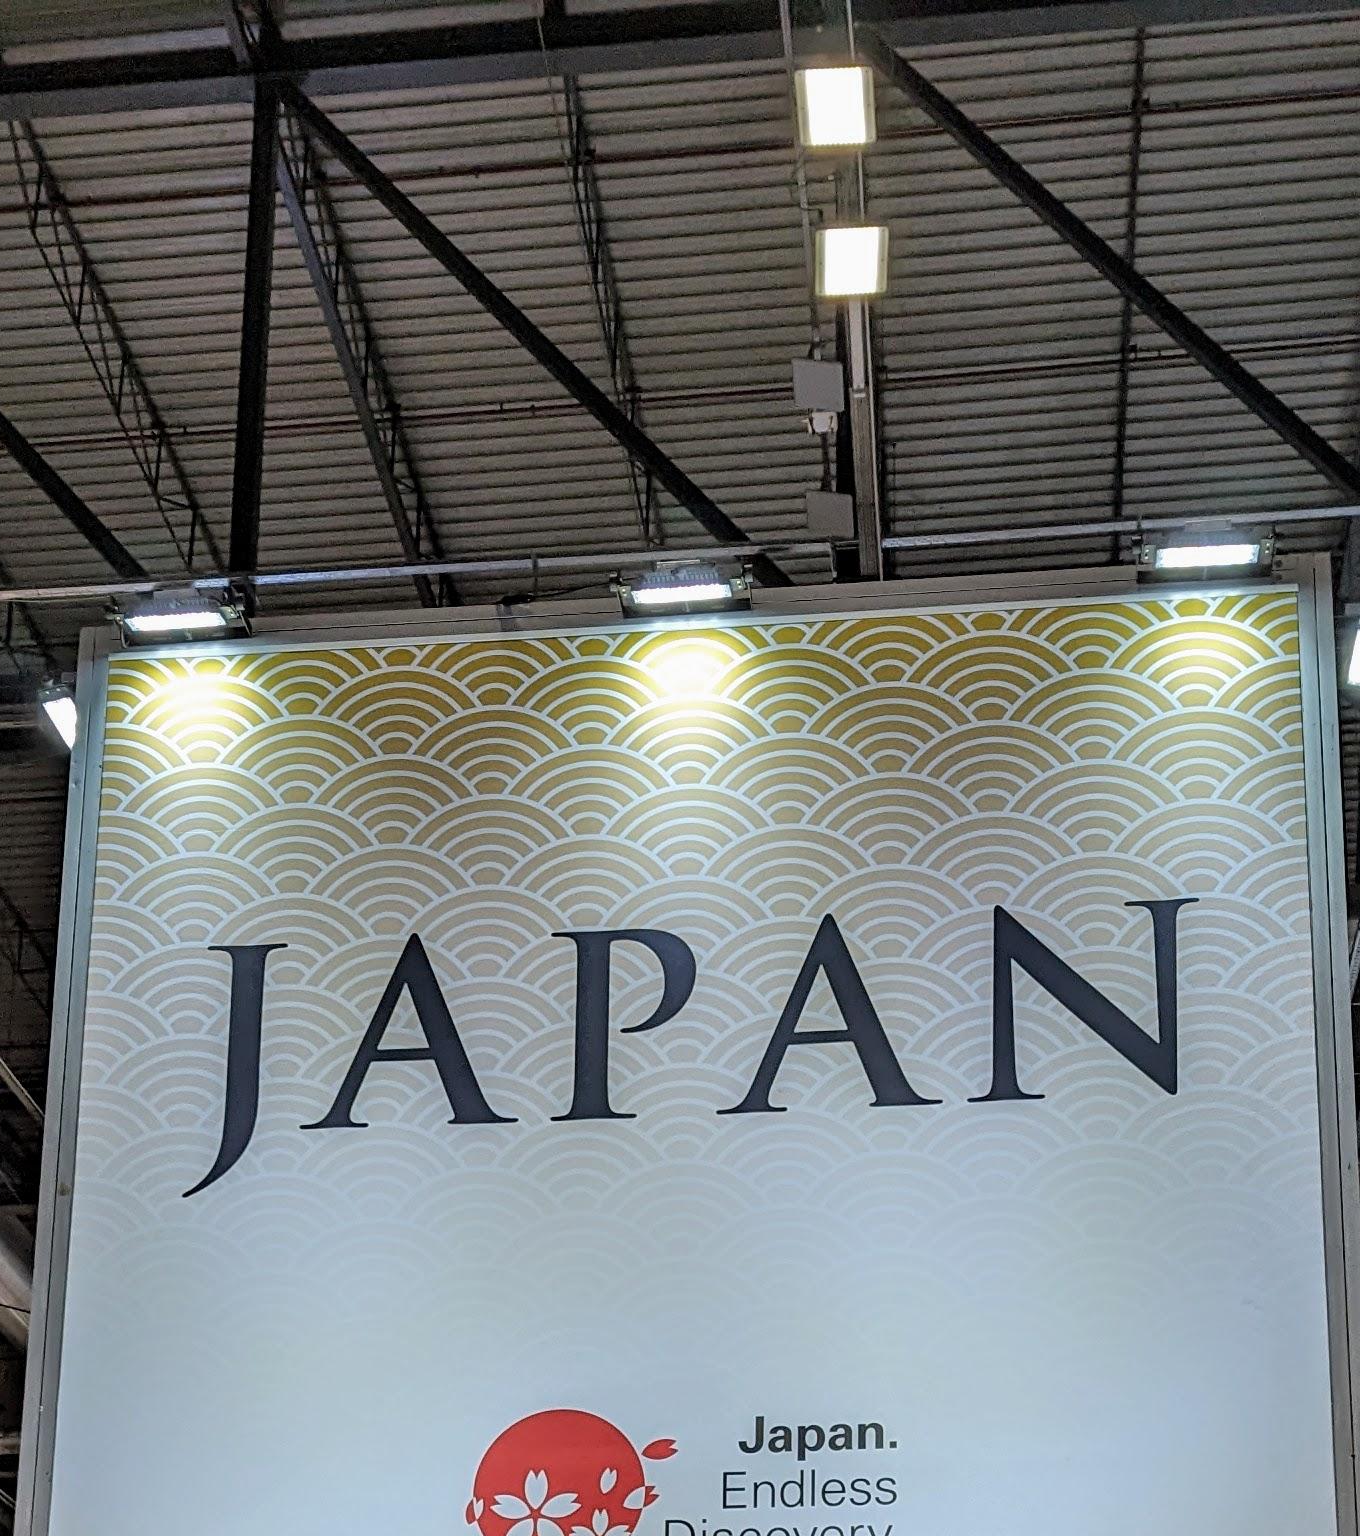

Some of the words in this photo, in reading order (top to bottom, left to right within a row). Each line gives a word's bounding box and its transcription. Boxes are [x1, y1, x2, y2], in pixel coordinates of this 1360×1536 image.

[182, 897, 1200, 1198] JAPAN
[737, 1415, 898, 1461] Japan.
[721, 1470, 898, 1510] Endless
